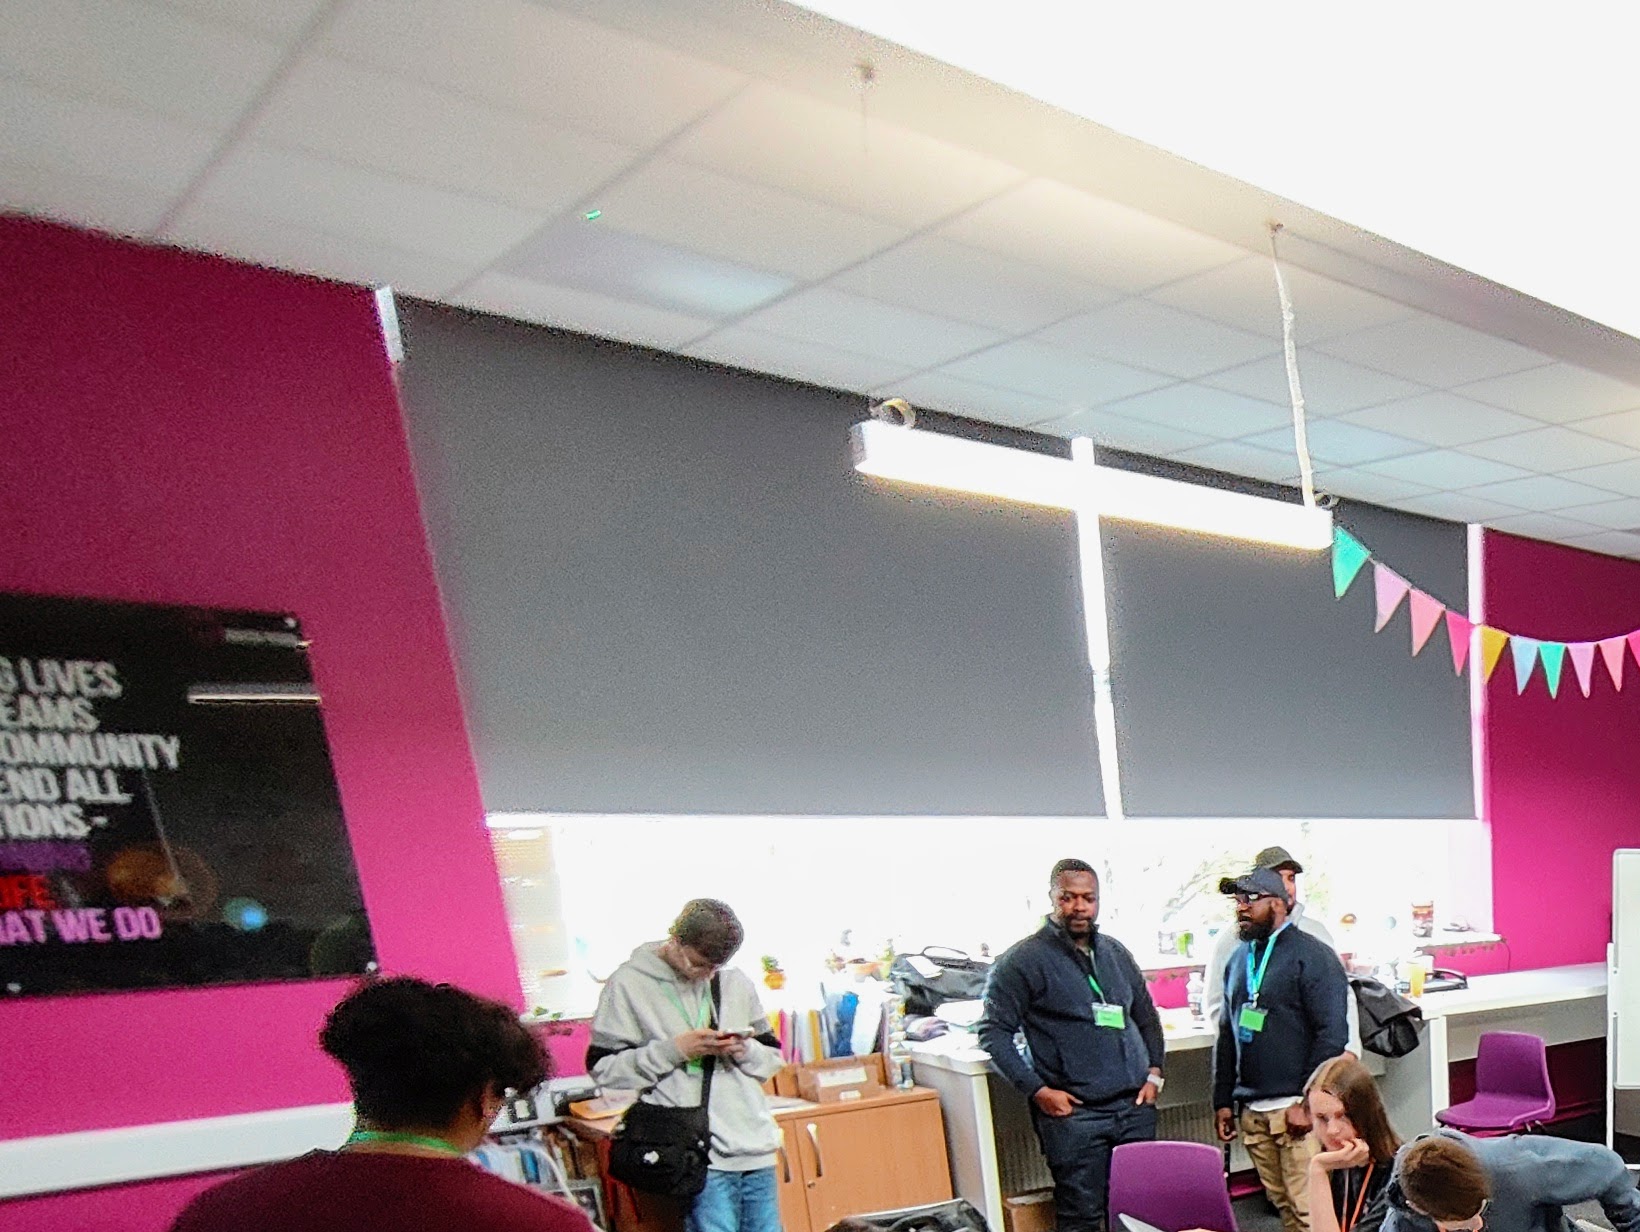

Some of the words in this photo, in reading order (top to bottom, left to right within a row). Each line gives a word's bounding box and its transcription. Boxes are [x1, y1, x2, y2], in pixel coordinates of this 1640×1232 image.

[19, 657, 123, 699] LIVES
[66, 768, 134, 804] ALL
[51, 907, 112, 944] WE
[113, 905, 163, 941] DO
